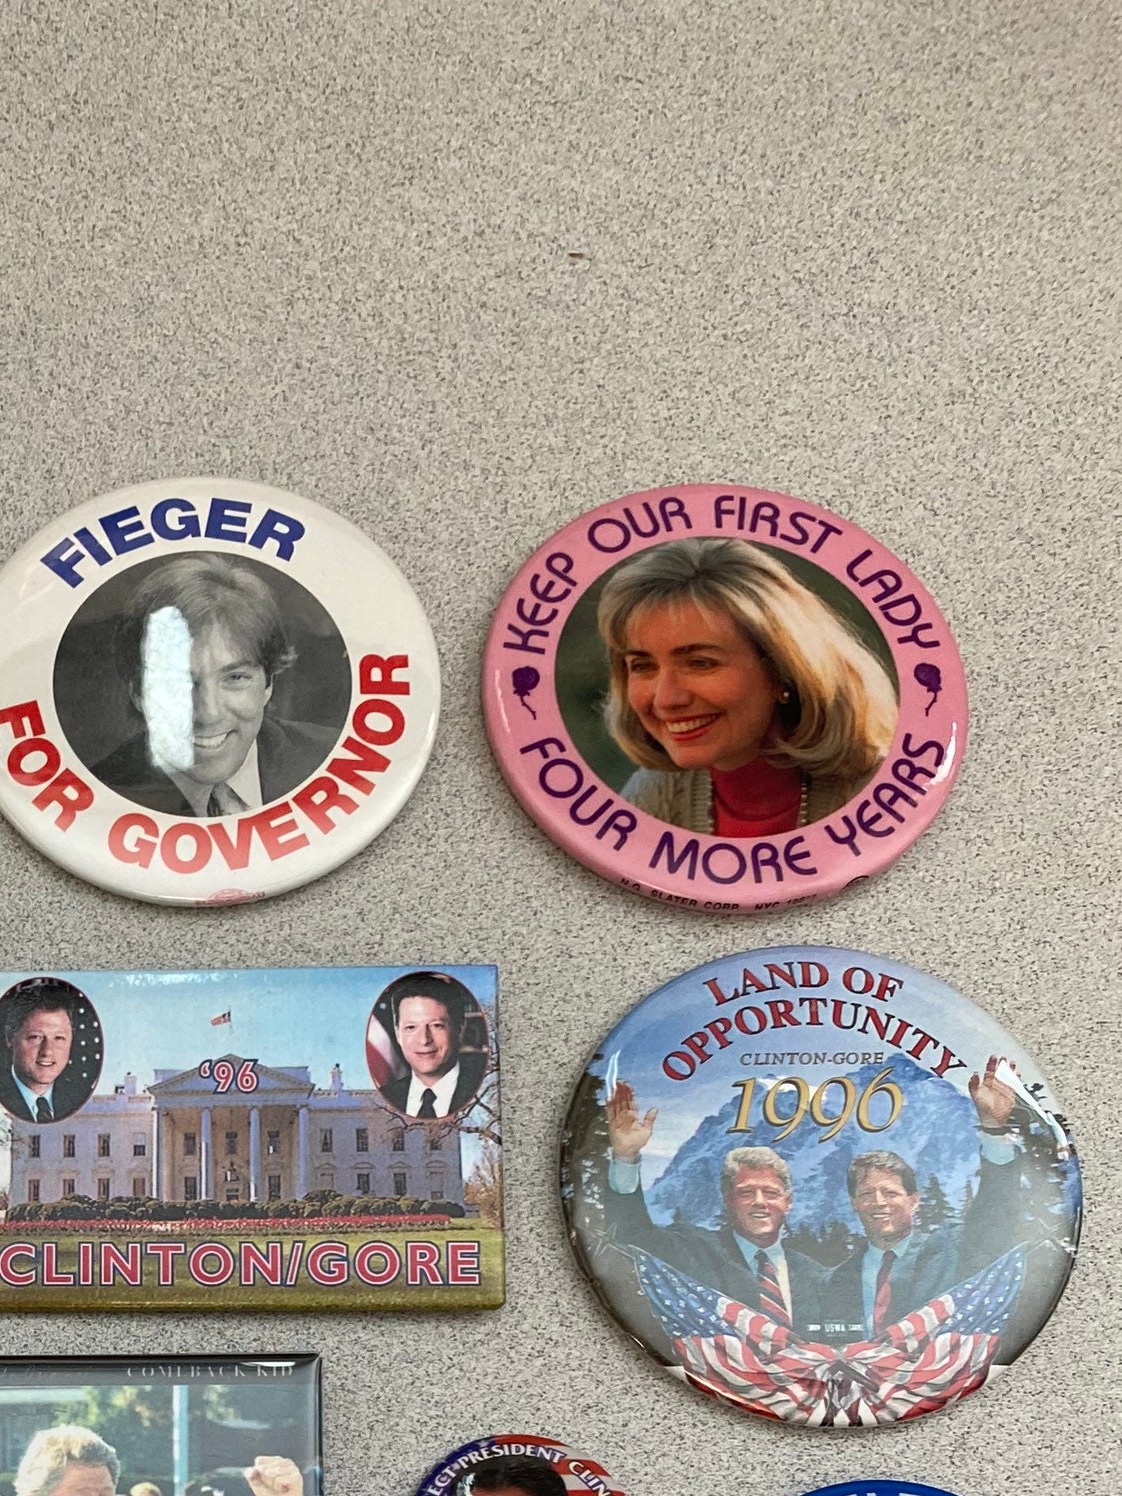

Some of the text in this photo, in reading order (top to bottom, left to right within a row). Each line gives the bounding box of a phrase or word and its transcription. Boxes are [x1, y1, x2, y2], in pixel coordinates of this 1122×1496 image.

[40, 497, 306, 589] FIEGER
[503, 495, 941, 655] KEEP OUR FIRST LADY
[107, 653, 410, 874] GOVERNOR
[519, 732, 945, 885] FOUR MORE YEARS
[702, 961, 905, 1007] LAND OF
[199, 1058, 260, 1094] '96
[661, 998, 968, 1083] OPPORTUNITY
[739, 1051, 884, 1067] CLINTON-GORE
[725, 1066, 906, 1144] 1996
[126, 1365, 294, 1378] COMEBACK KID
[456, 1443, 568, 1470] PRESIDENT
